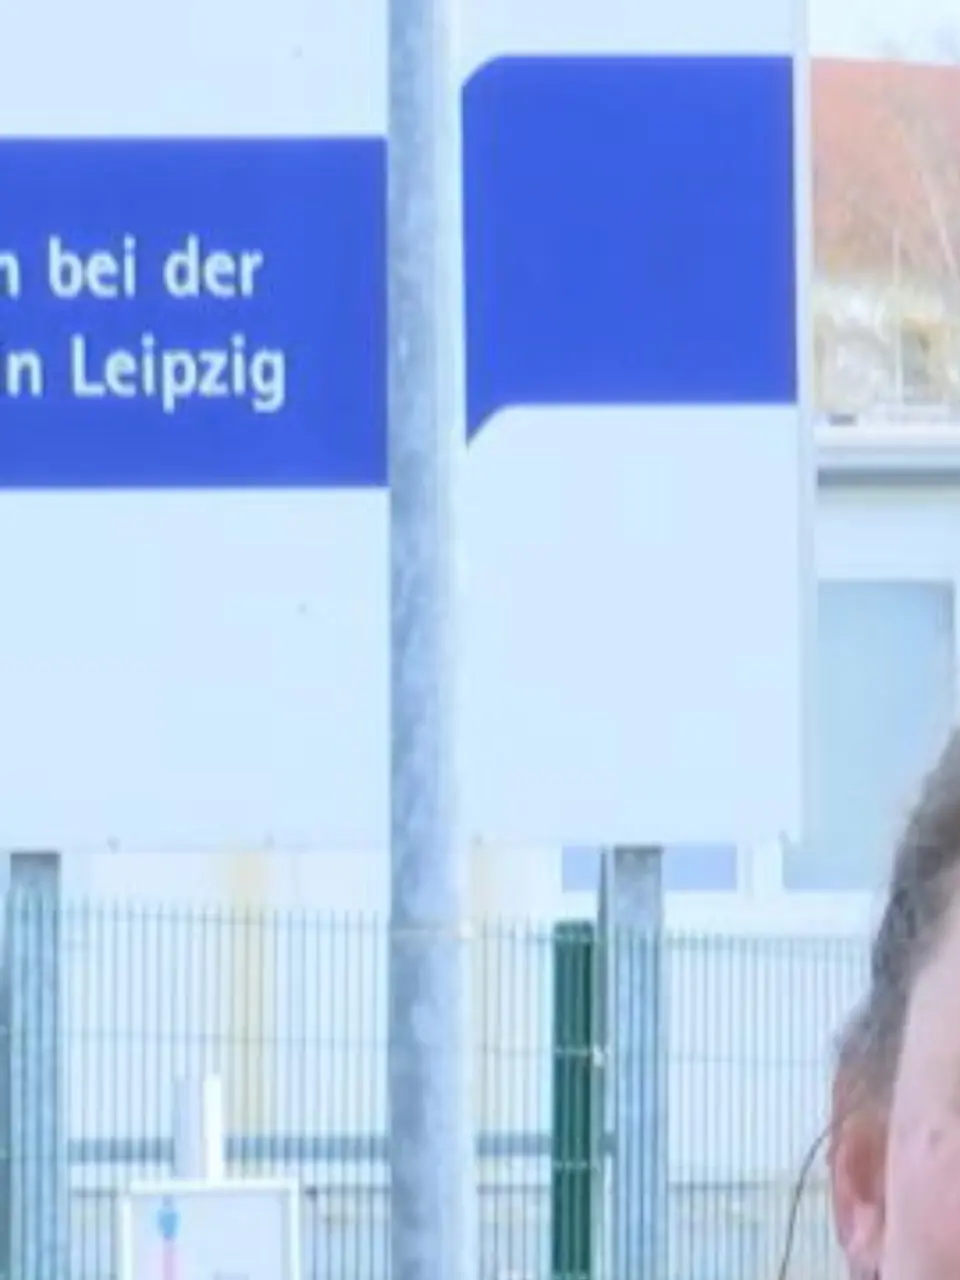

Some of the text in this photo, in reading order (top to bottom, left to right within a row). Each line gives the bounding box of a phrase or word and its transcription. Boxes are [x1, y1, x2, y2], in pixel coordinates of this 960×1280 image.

[50, 233, 136, 298] bei
[164, 233, 264, 298] der
[71, 332, 286, 413] Leipzig
